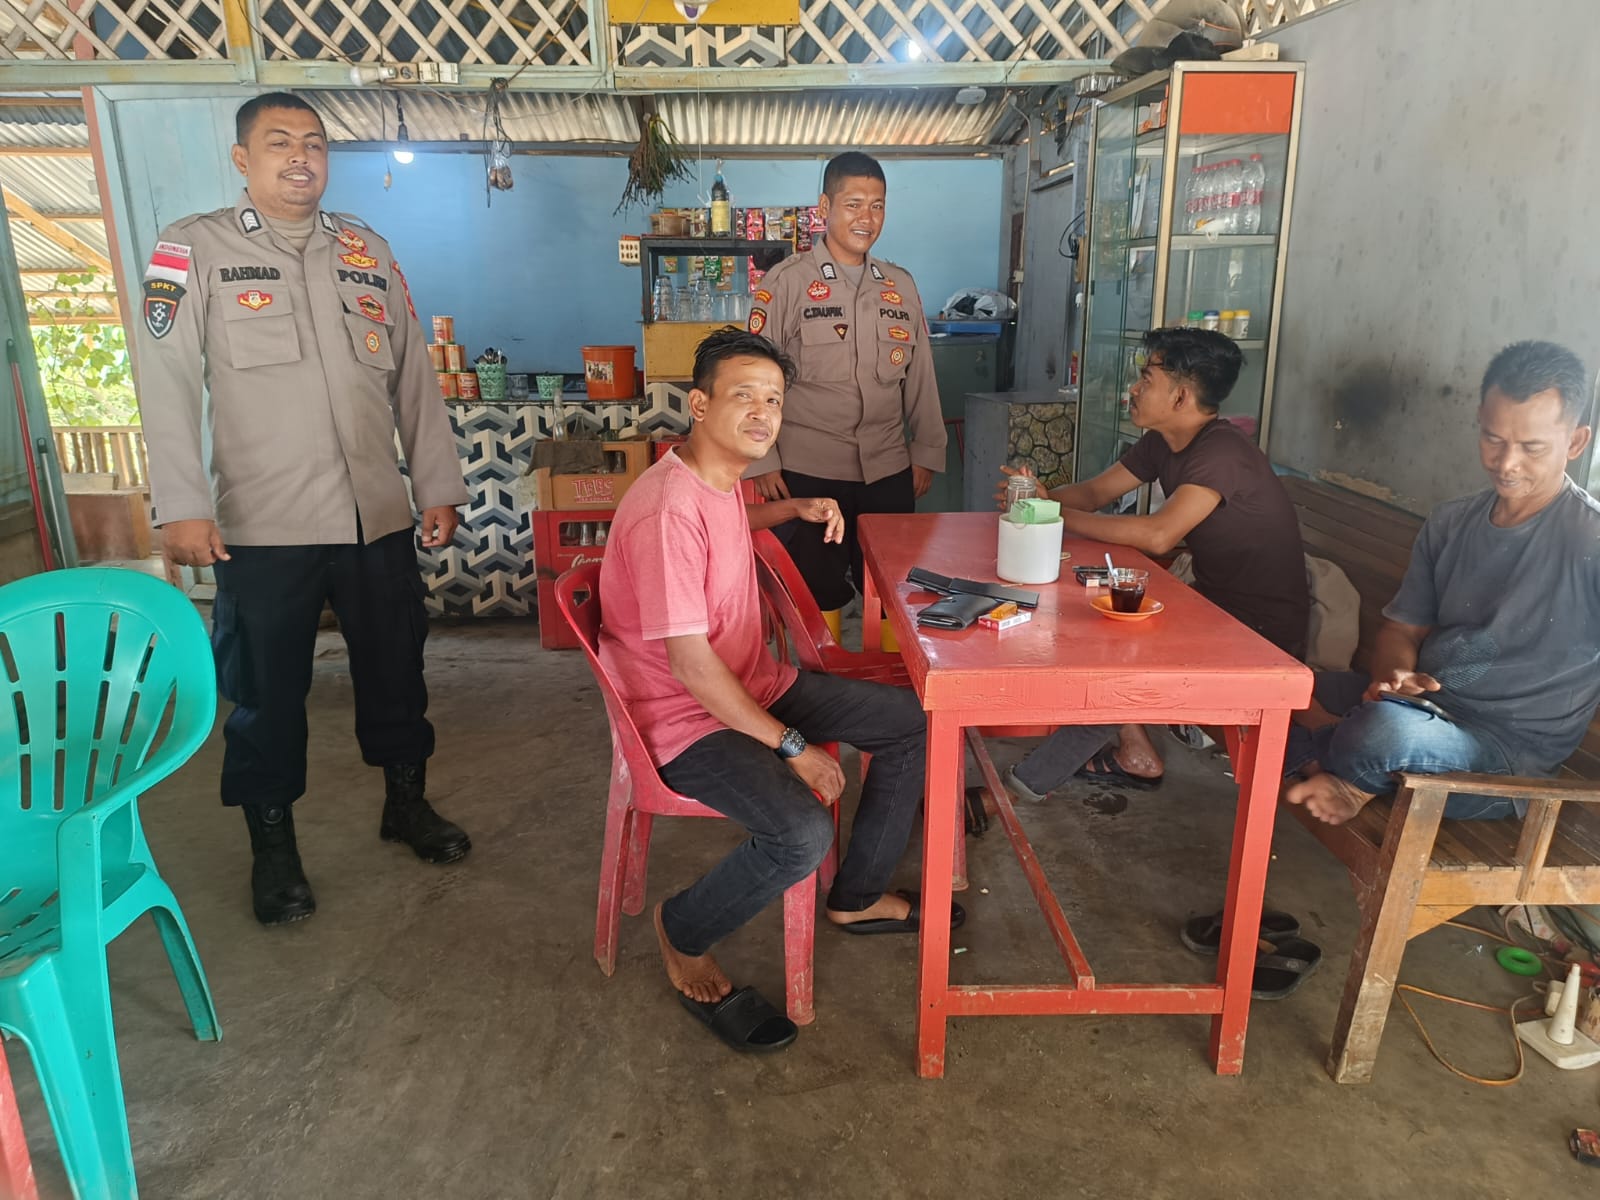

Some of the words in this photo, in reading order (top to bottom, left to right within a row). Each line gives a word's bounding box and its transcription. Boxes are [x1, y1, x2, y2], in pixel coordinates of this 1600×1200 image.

[158, 243, 189, 254] INDONESIA
[219, 266, 281, 282] RAHMAD
[336, 269, 388, 292] POLRI
[150, 281, 177, 293] SPKT
[879, 308, 910, 321] POLRI
